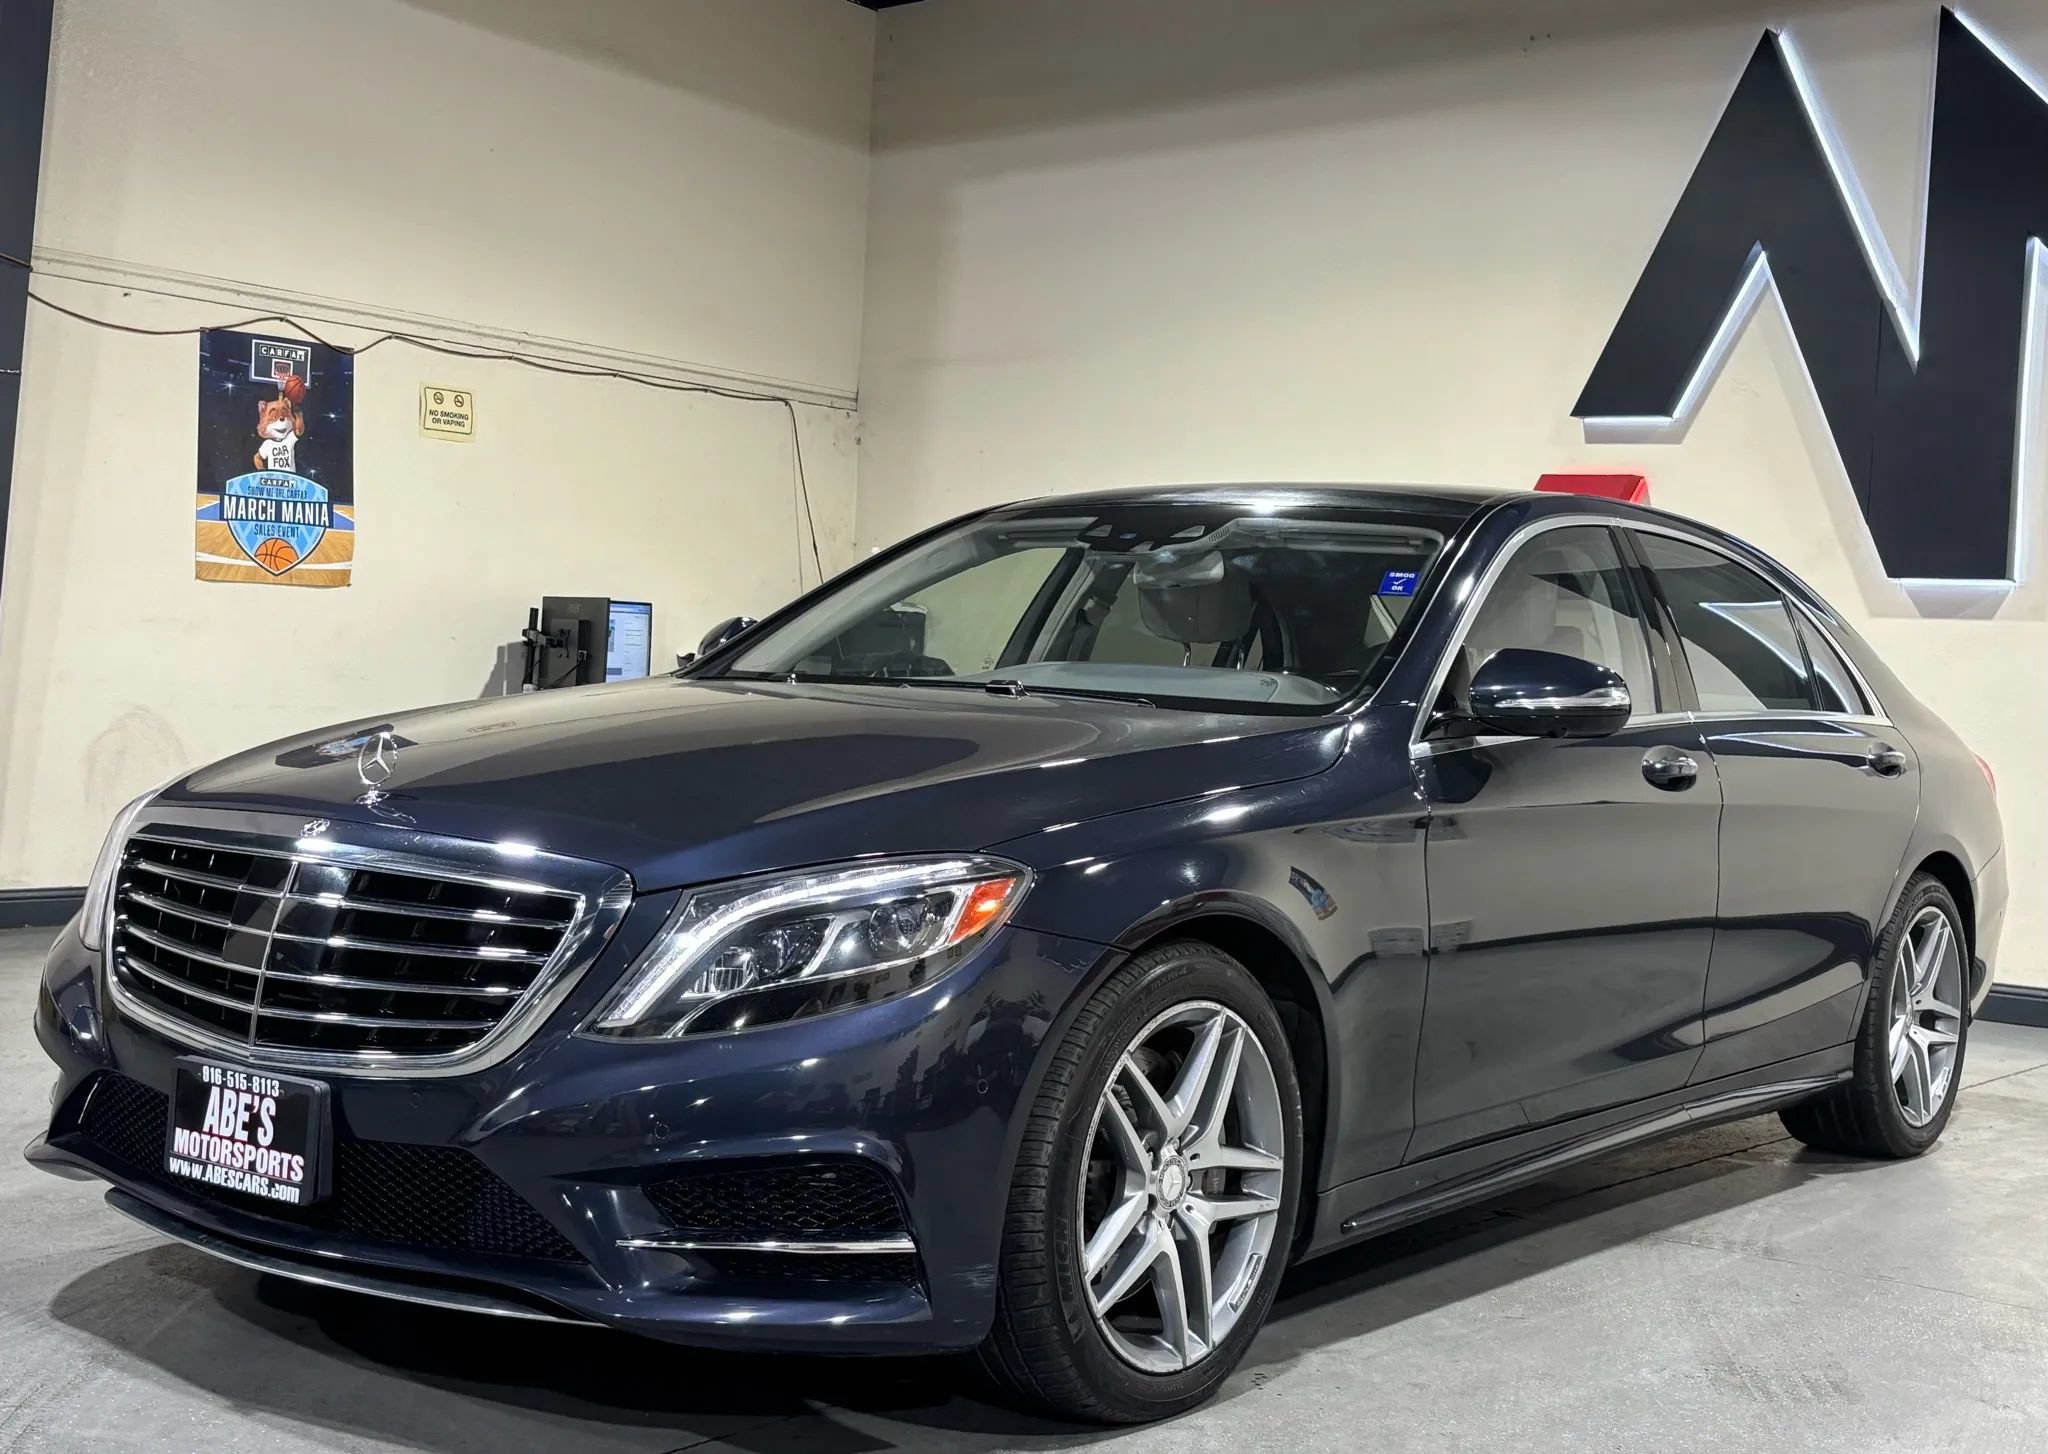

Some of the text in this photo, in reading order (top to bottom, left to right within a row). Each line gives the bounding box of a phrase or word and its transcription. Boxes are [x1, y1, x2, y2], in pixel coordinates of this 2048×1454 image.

[261, 345, 305, 361] CARFAX
[432, 417, 465, 427] OR VAPING
[440, 411, 468, 420] SMOKING
[272, 445, 289, 457] CAR
[273, 457, 291, 468] FOX
[260, 478, 297, 489] CARFAX
[224, 495, 329, 526] MARCH MANIA
[254, 523, 300, 538] SALES EVENT
[202, 1066, 280, 1097] 916-515-8113
[202, 1085, 276, 1147] ABE'S
[174, 1127, 304, 1182] MOTORSPORTS
